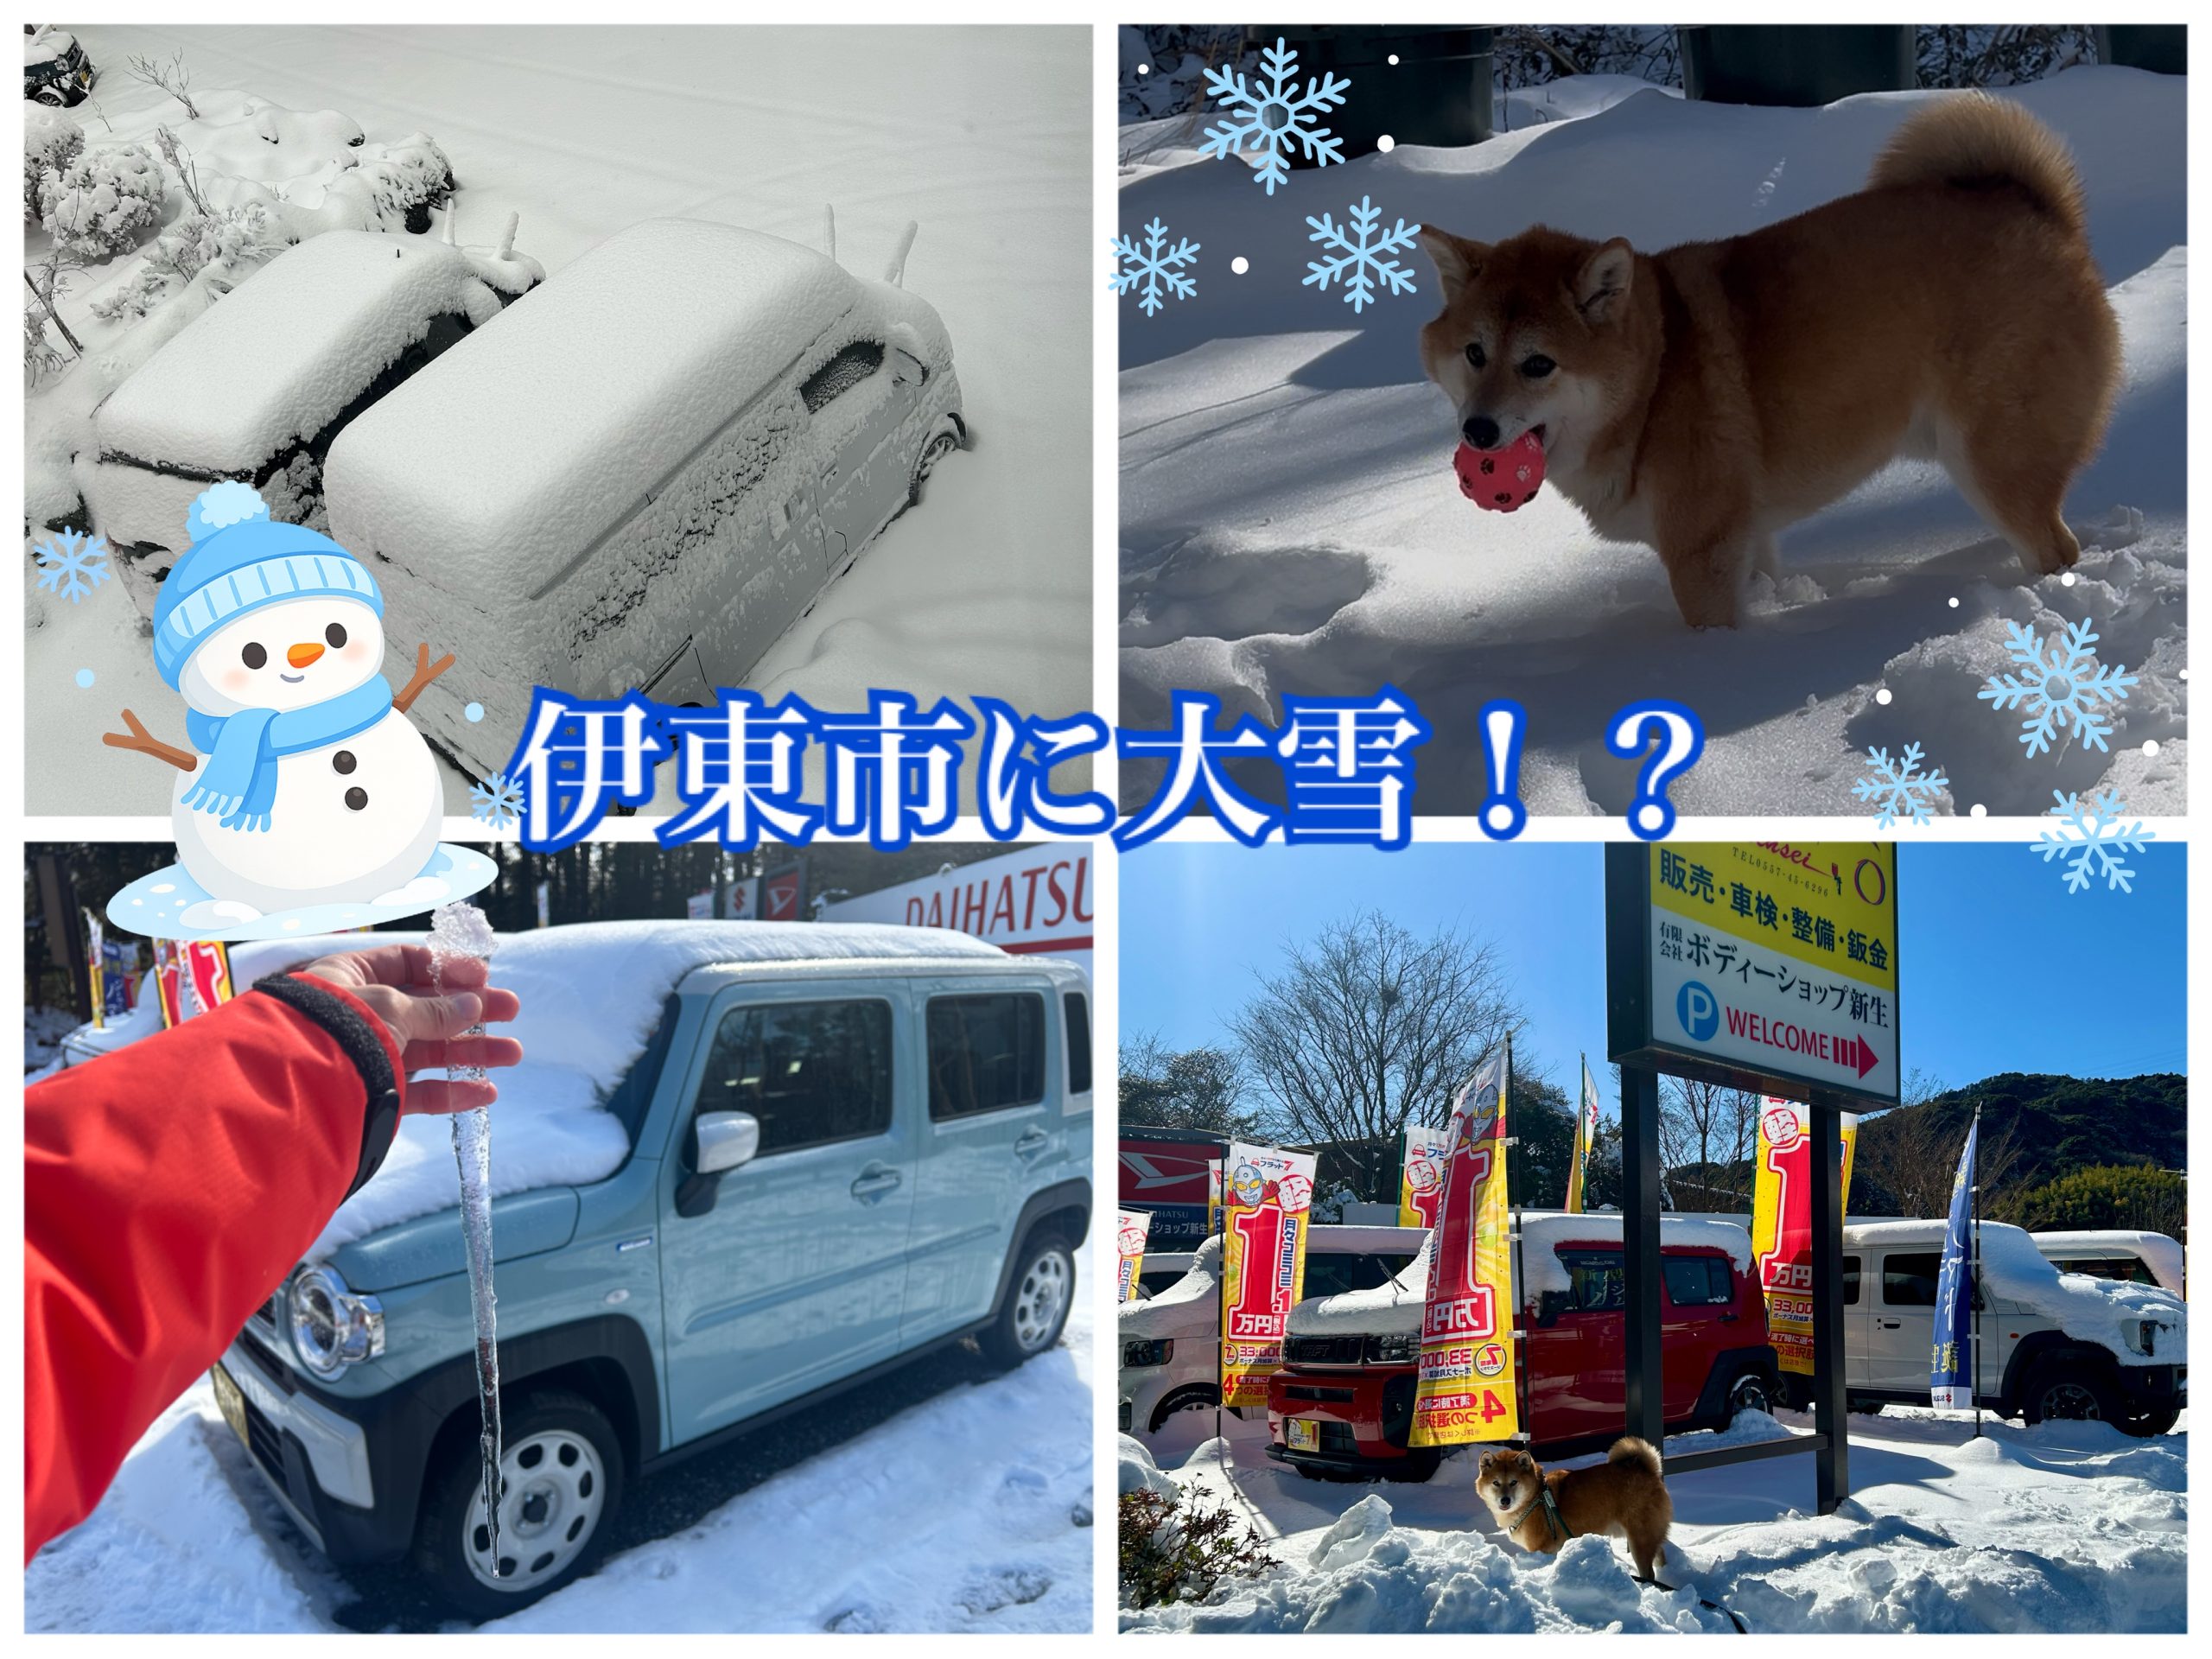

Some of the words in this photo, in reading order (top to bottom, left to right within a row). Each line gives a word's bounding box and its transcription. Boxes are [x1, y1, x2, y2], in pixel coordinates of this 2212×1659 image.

[1660, 848, 1888, 971] 販売・車検・整備・鈑金
[1687, 933, 1889, 1028] ボディーショップ新生
[1688, 987, 1713, 1034] P
[1726, 1006, 1829, 1060] WELCOME
[1770, 1262, 1812, 1287] 万円
[1236, 1313, 1273, 1334] 万円
